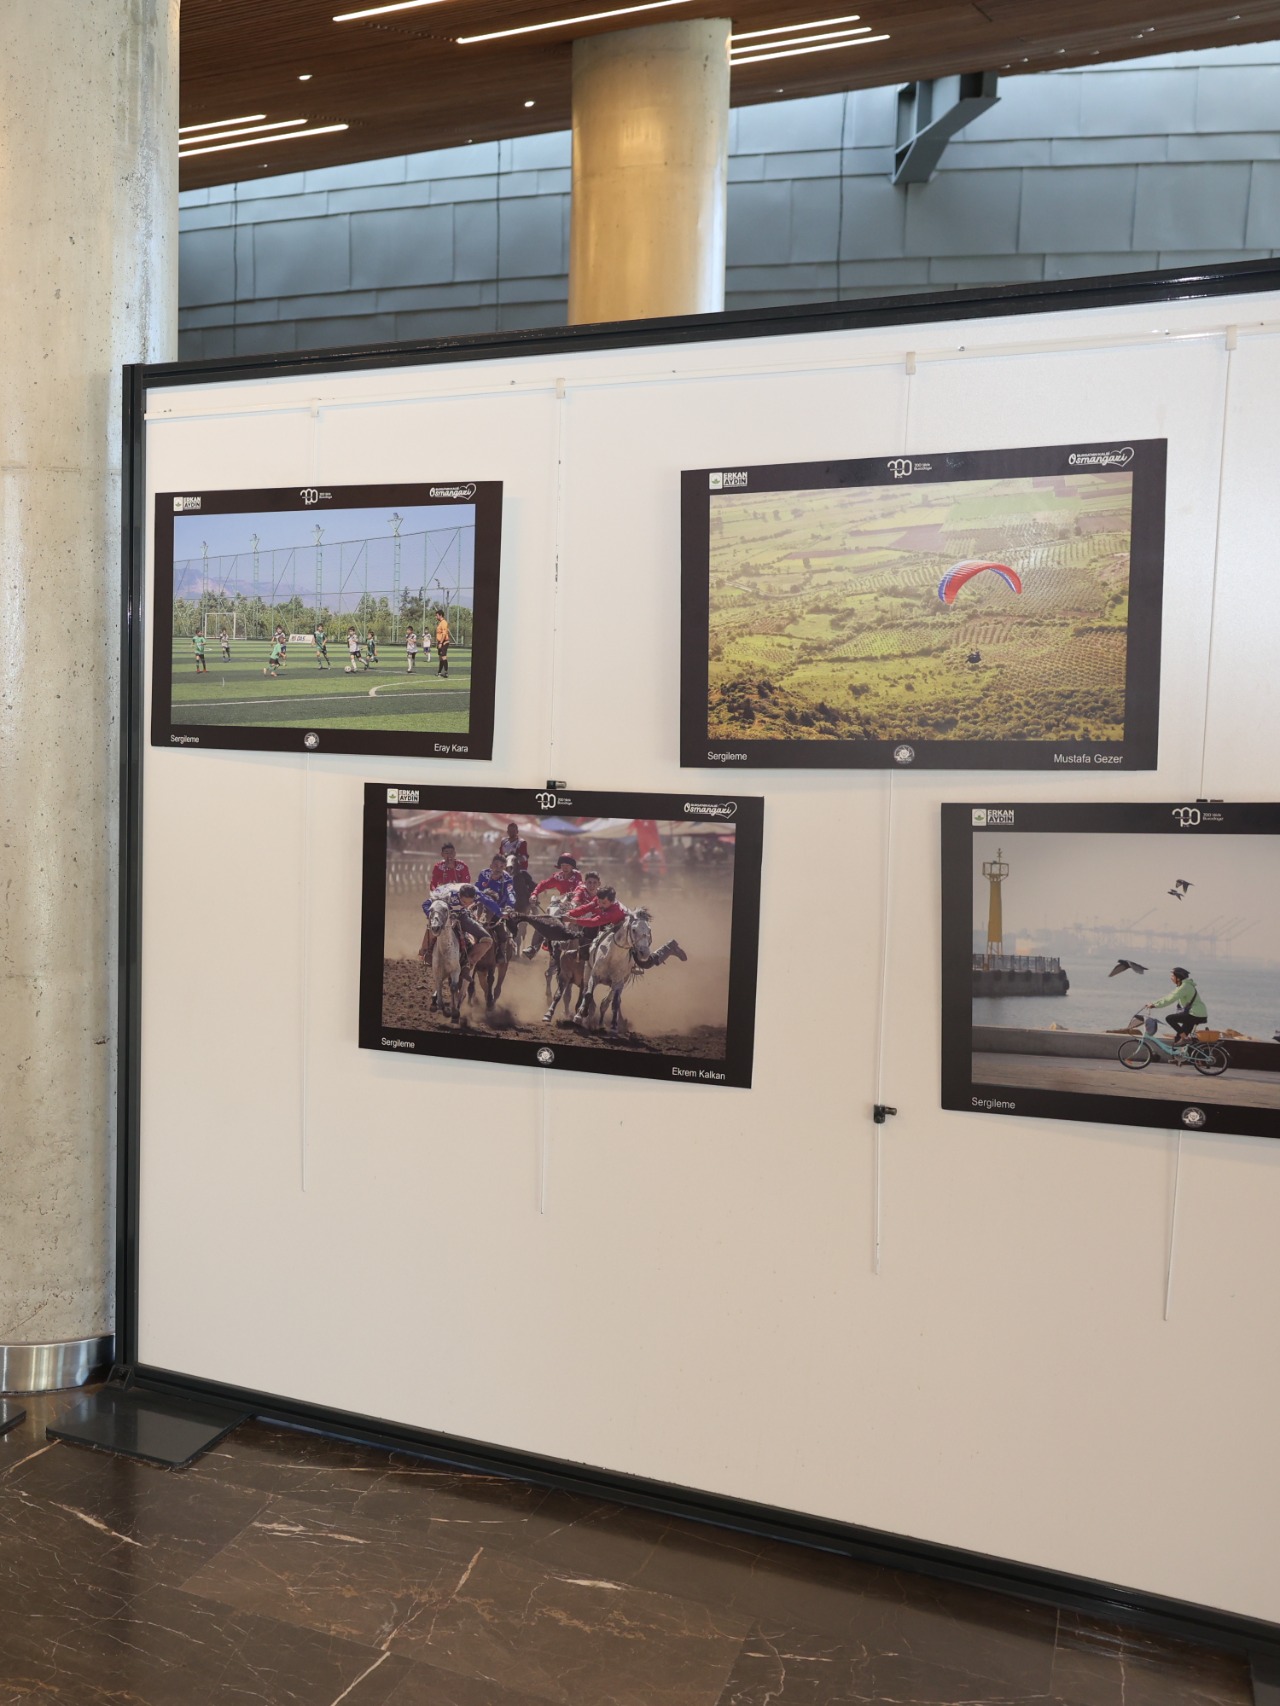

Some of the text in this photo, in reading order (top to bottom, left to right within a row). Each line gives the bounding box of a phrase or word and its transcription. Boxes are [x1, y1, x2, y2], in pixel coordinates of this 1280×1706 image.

[1068, 453, 1128, 466] Osmangazi
[429, 487, 472, 499] Osmangazi
[170, 734, 200, 744] Sergileme
[434, 743, 469, 753] Eray Kara
[707, 751, 747, 762] Sergileme
[1053, 753, 1124, 764] Mustafa Gezer
[683, 802, 732, 816] Osmangazi
[381, 1037, 415, 1048] Sergileme
[672, 1067, 726, 1080] Ekrem Kalkan
[971, 1097, 1016, 1109] Sergileme
